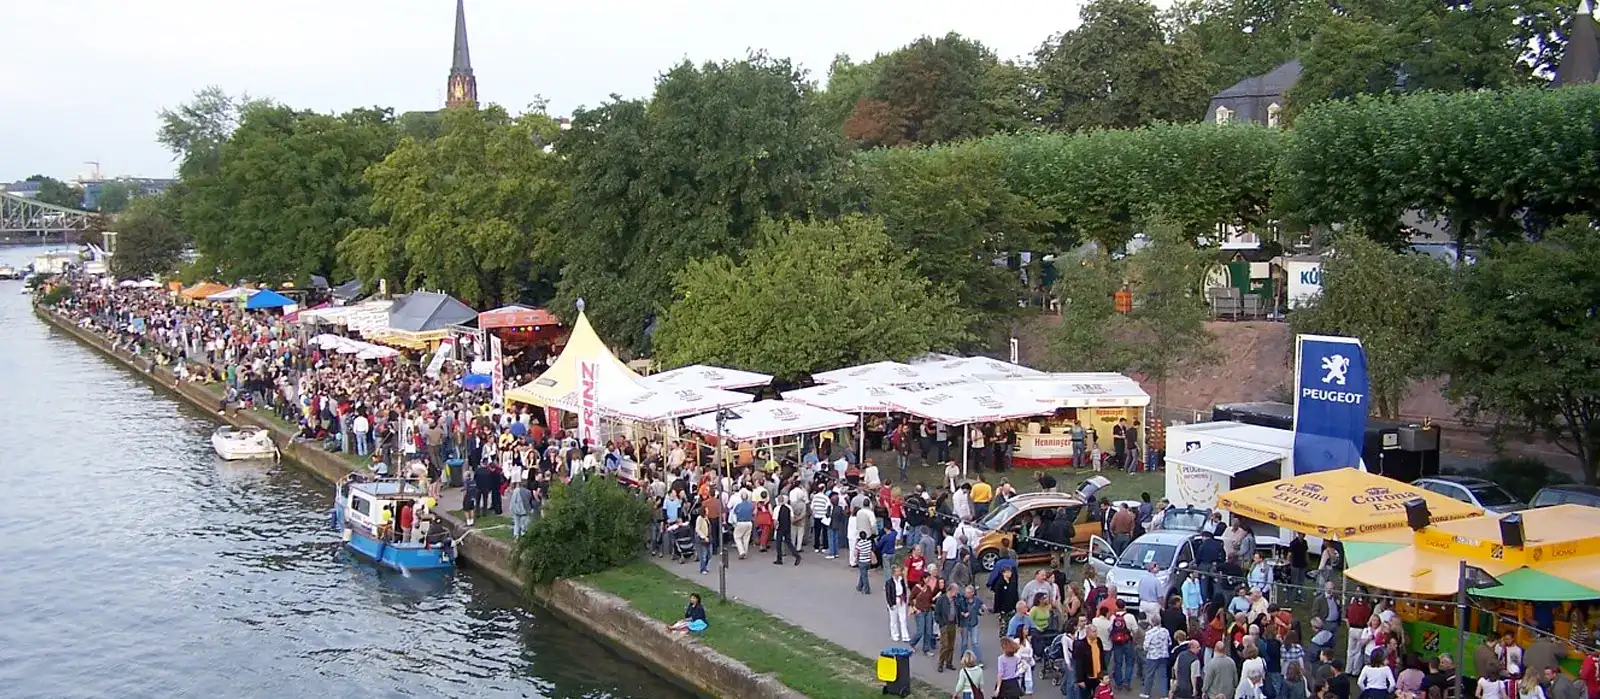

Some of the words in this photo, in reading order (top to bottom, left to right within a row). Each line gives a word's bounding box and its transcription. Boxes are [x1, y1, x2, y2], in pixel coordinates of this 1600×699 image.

[1300, 267, 1323, 285] KÜ
[582, 361, 595, 445] PRINZ
[1302, 387, 1364, 404] PEUGEOT
[1034, 437, 1071, 447] Henninger
[1273, 492, 1310, 508] Extra
[1274, 483, 1329, 502] Corona
[1351, 491, 1417, 505] Corona
[1374, 502, 1402, 511] Ext
[1359, 523, 1387, 533] Corona
